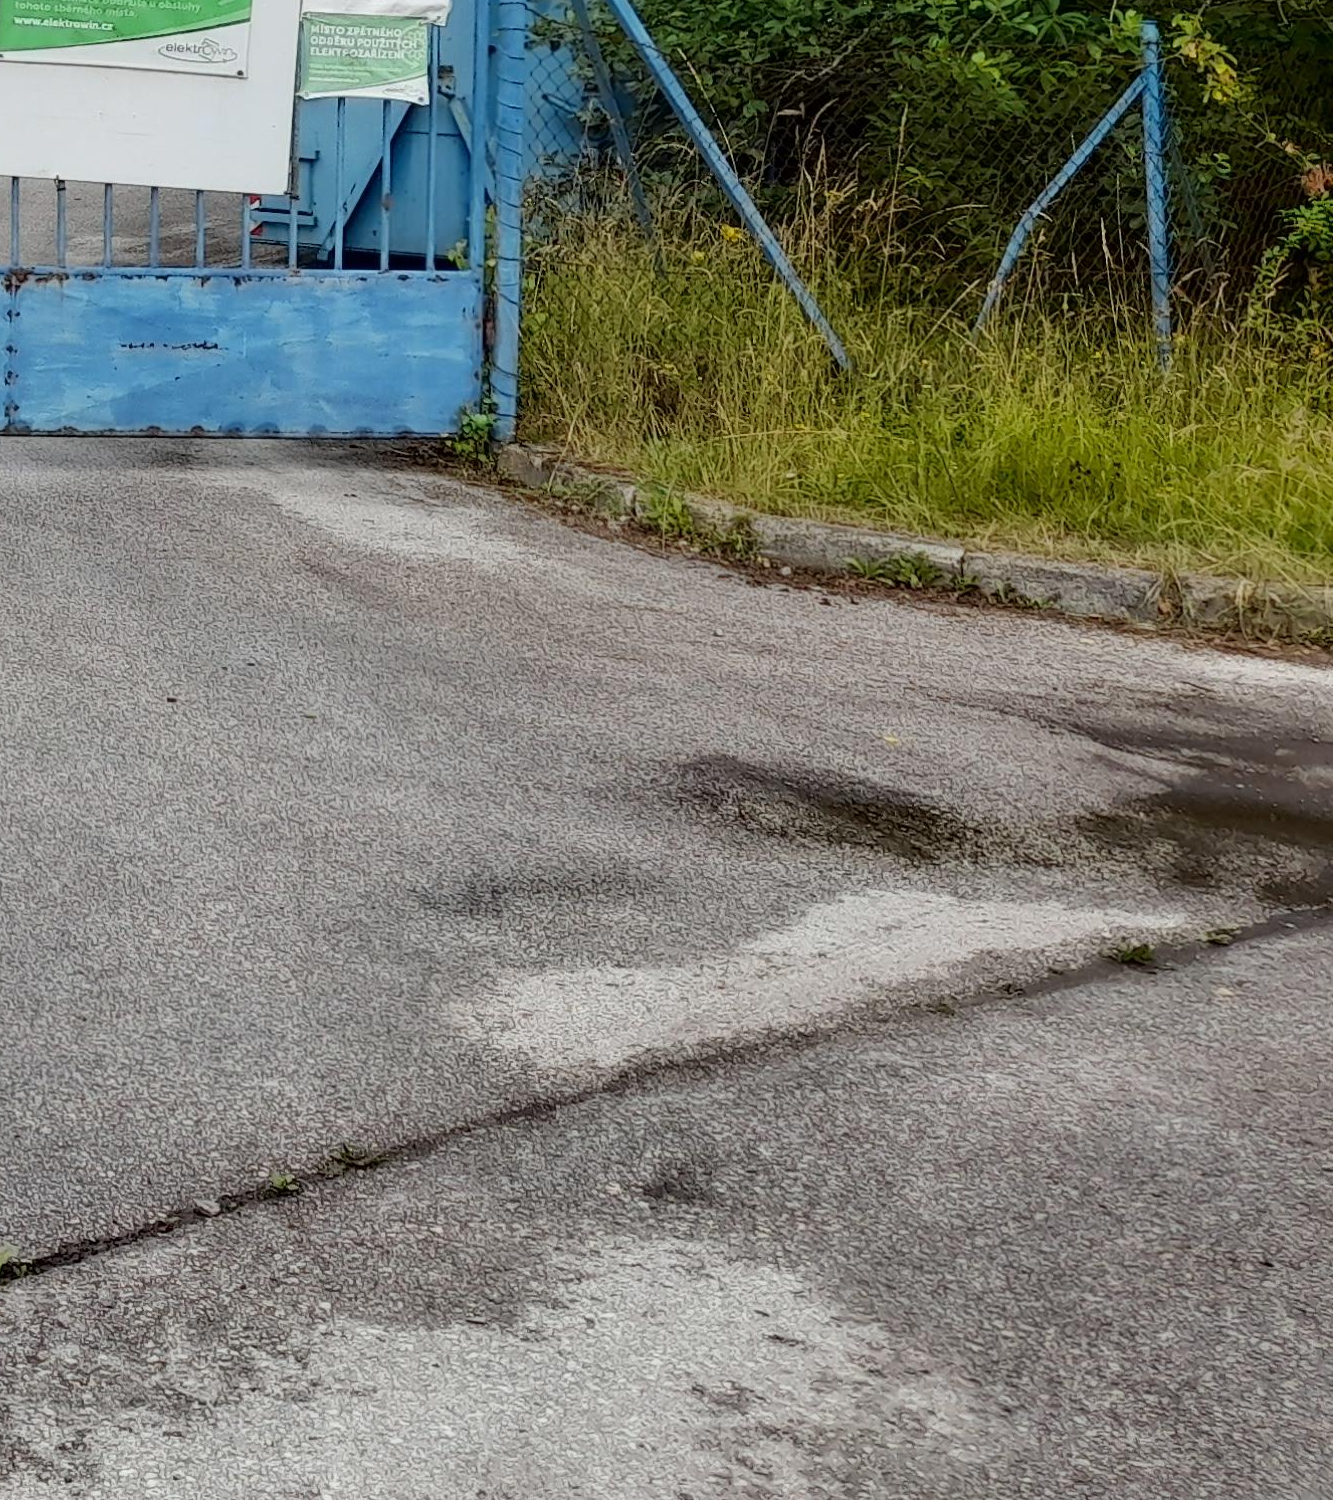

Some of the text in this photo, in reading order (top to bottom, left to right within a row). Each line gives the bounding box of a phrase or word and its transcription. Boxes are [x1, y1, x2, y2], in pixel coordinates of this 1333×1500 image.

[15, 1, 51, 12] tohoto
[158, 0, 201, 13] obsluhy
[13, 16, 114, 32] www.elektrowin.cz
[311, 24, 402, 37] MÍSTO ZPĚTNÉHO
[310, 36, 417, 49] ODBĚRU POUŽITÝCH
